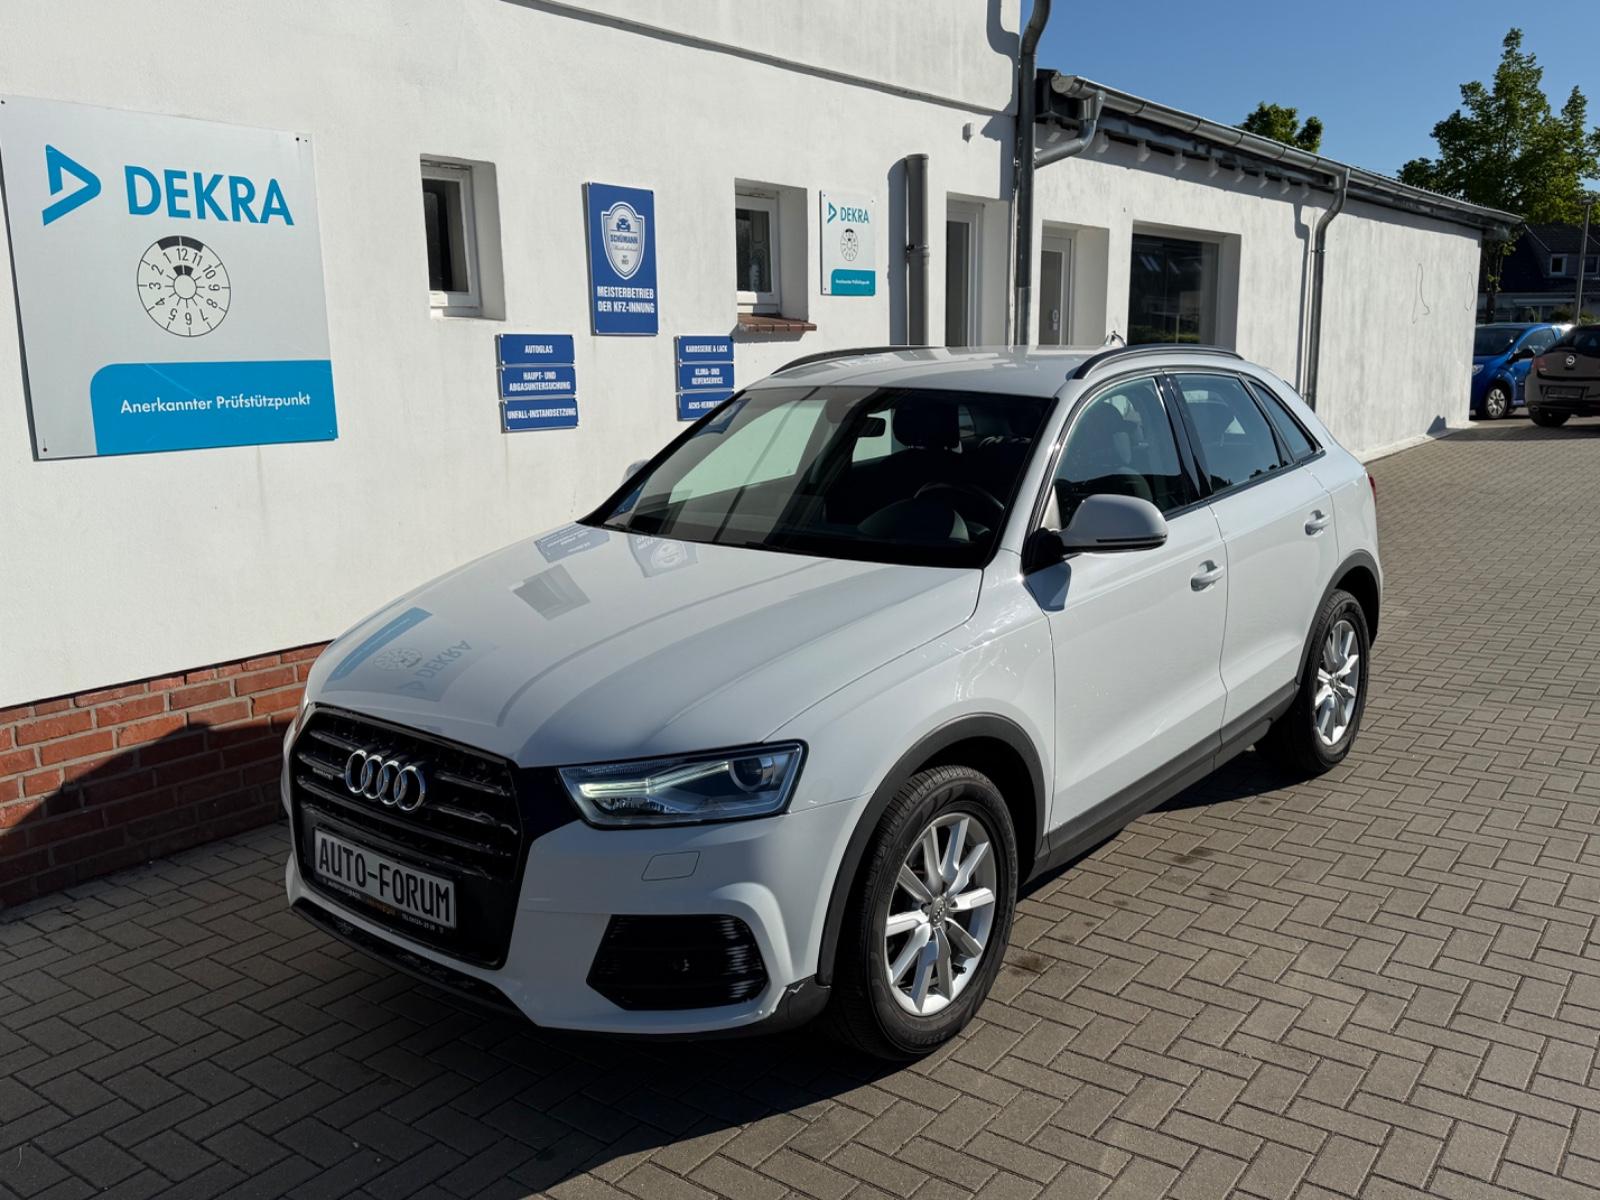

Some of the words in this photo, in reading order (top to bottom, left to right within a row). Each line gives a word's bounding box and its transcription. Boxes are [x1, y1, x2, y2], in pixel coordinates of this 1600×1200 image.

[124, 164, 295, 226] DEKRA
[839, 206, 870, 224] DEKRA
[162, 251, 172, 264] 1
[176, 247, 189, 261] 12
[192, 251, 203, 267] 11
[150, 263, 165, 276] 2
[202, 263, 217, 280] 10
[148, 281, 162, 291] 3
[208, 283, 221, 292] 9
[596, 285, 655, 300] MEISTERBETRIEB
[154, 297, 166, 306] 4
[206, 298, 218, 309] 8
[597, 300, 613, 313] DER
[613, 301, 655, 314] KFZ-INNUNG
[168, 307, 178, 322] 5
[184, 312, 193, 326] 6
[199, 308, 209, 322] 7
[524, 344, 554, 354] AUTOGLAS
[522, 370, 544, 381] HAUPT-
[544, 371, 557, 381] UND
[509, 381, 572, 393] ABGASUNTERSUCHUNG
[120, 397, 212, 414] Anerkannter
[216, 391, 311, 411] Prüfstützpunkt
[506, 407, 577, 420] UNFALL-INSTANDSETZUNG
[318, 837, 450, 923] AUTO-FORUM
